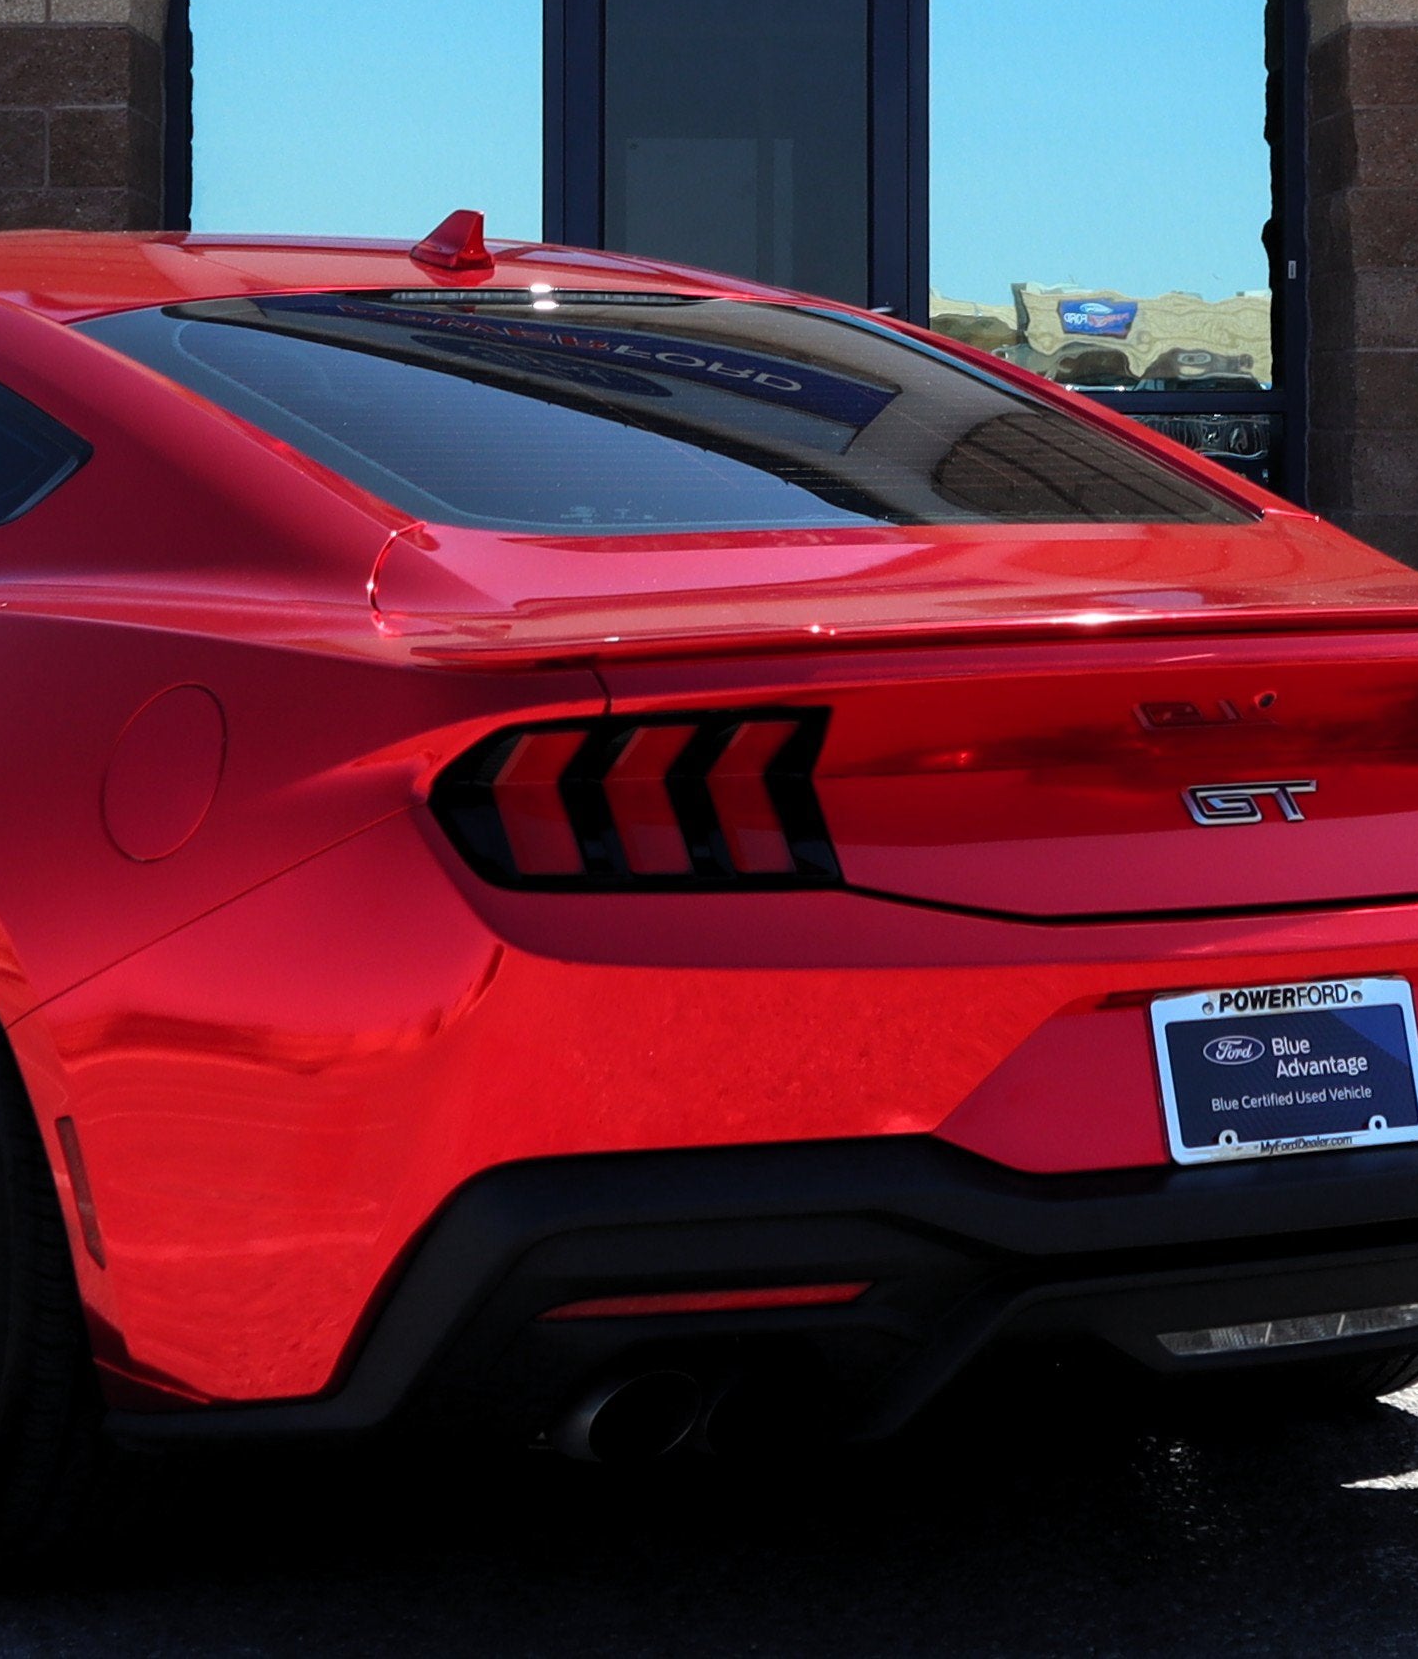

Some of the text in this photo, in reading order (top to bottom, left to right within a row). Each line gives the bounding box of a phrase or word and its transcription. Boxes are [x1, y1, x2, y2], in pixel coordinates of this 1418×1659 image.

[1182, 779, 1317, 825] GT
[1215, 1039, 1254, 1061] Ford
[1271, 1036, 1311, 1057] Blue
[1276, 1056, 1368, 1078] Advantage
[1211, 1085, 1372, 1112] Blue Certified Used Vehicle
[1260, 1136, 1352, 1155] MyFordDealer.com
